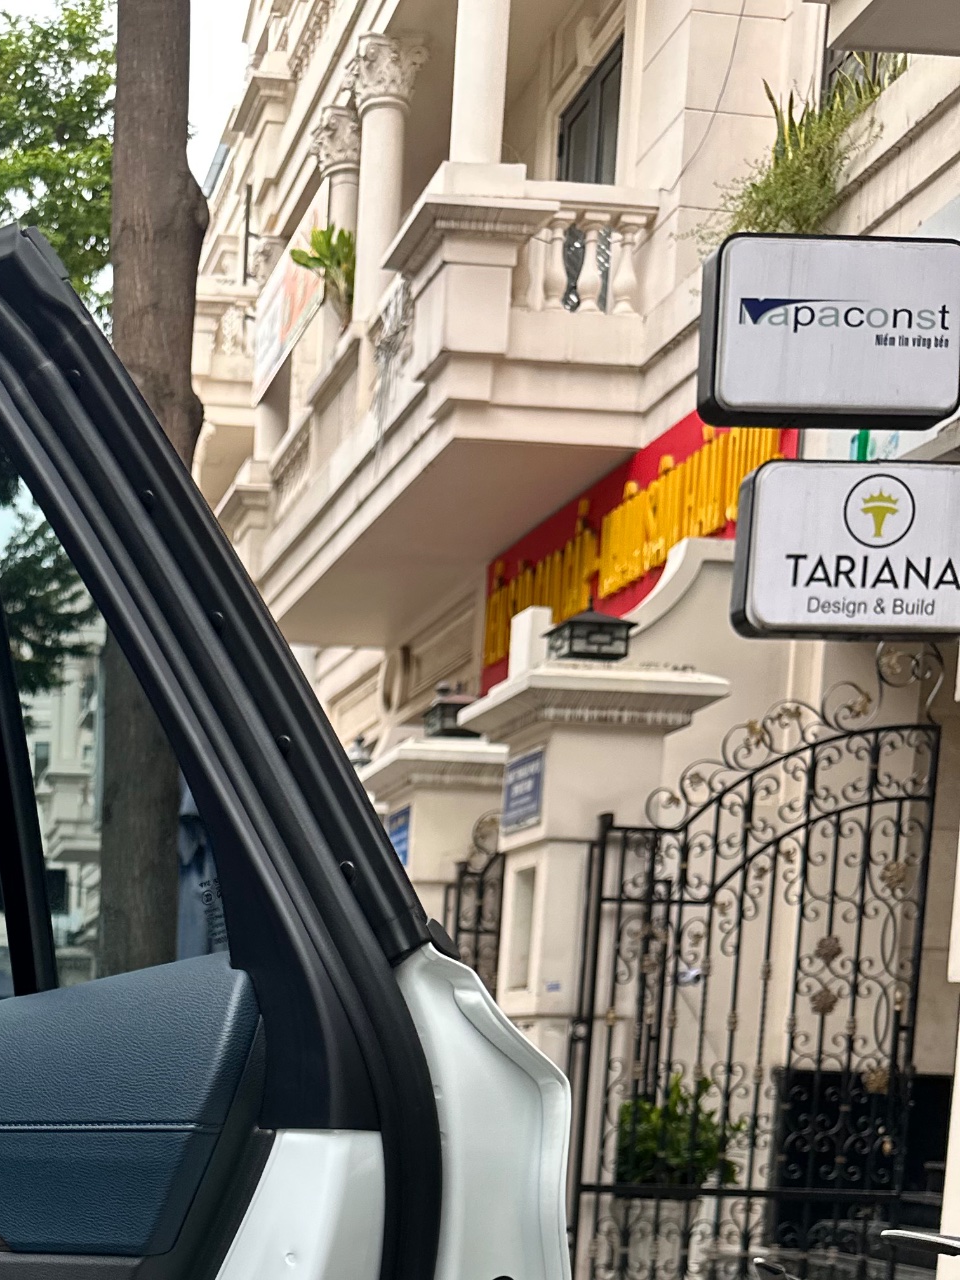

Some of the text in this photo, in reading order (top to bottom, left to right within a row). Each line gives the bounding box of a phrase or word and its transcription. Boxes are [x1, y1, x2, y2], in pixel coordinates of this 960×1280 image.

[898, 334, 910, 347] tin
[785, 553, 960, 590] TARIANA
[806, 596, 936, 618] Design & Build
